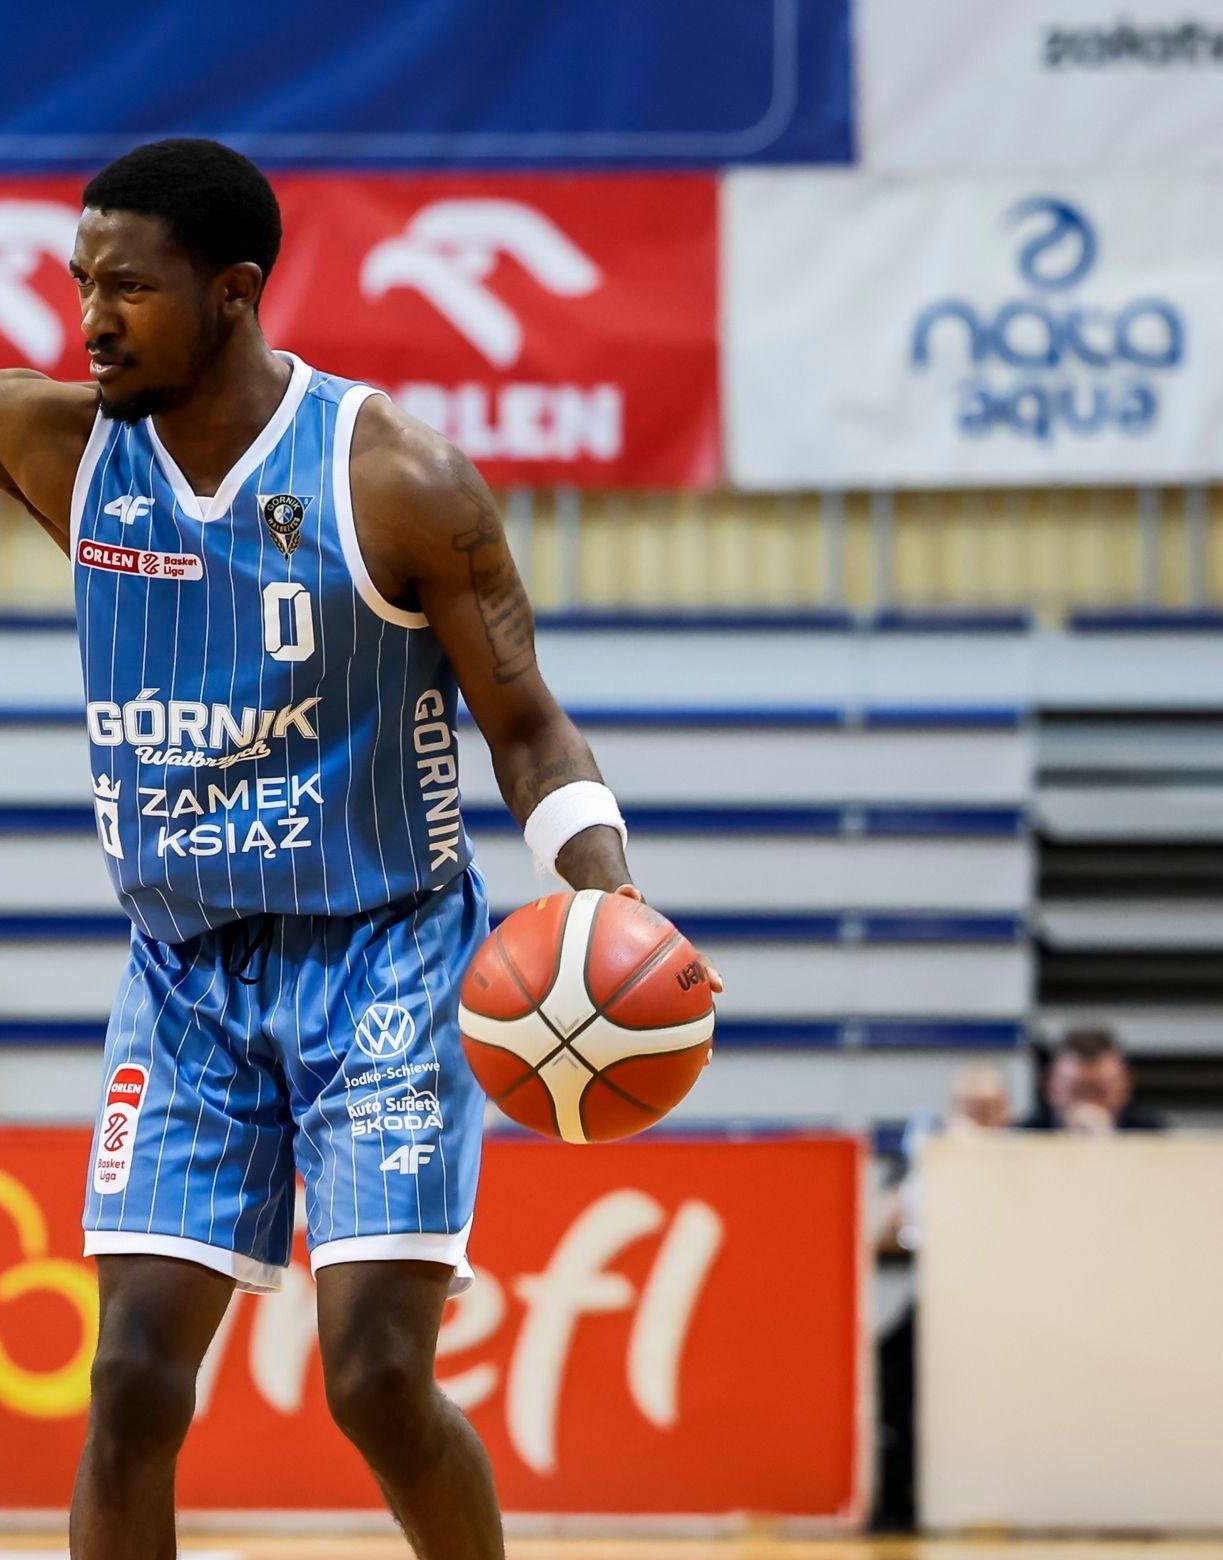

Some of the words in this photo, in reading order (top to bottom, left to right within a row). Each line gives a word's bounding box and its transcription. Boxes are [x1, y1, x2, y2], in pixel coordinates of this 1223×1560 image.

[374, 382, 623, 460] RLEN
[104, 496, 155, 525] 4F
[82, 546, 134, 568] ORLEN
[164, 556, 198, 566] Basket
[164, 566, 185, 577] Liga
[263, 582, 315, 661] 0
[87, 688, 323, 750] GÓRNIK
[135, 740, 271, 768] Wałbrzych
[138, 774, 325, 818] ZAMEK
[157, 808, 312, 858] KSIĄŻ
[111, 1083, 142, 1094] ORLEN
[345, 1062, 441, 1089] Jodko-Schiewe
[348, 1102, 381, 1119] Auto
[386, 1097, 440, 1114] Sudety
[351, 1115, 443, 1136] SKODA
[98, 1158, 126, 1169] Basket
[380, 1144, 436, 1175] 4F
[99, 1170, 117, 1182] Liga
[194, 1188, 724, 1475] refl
